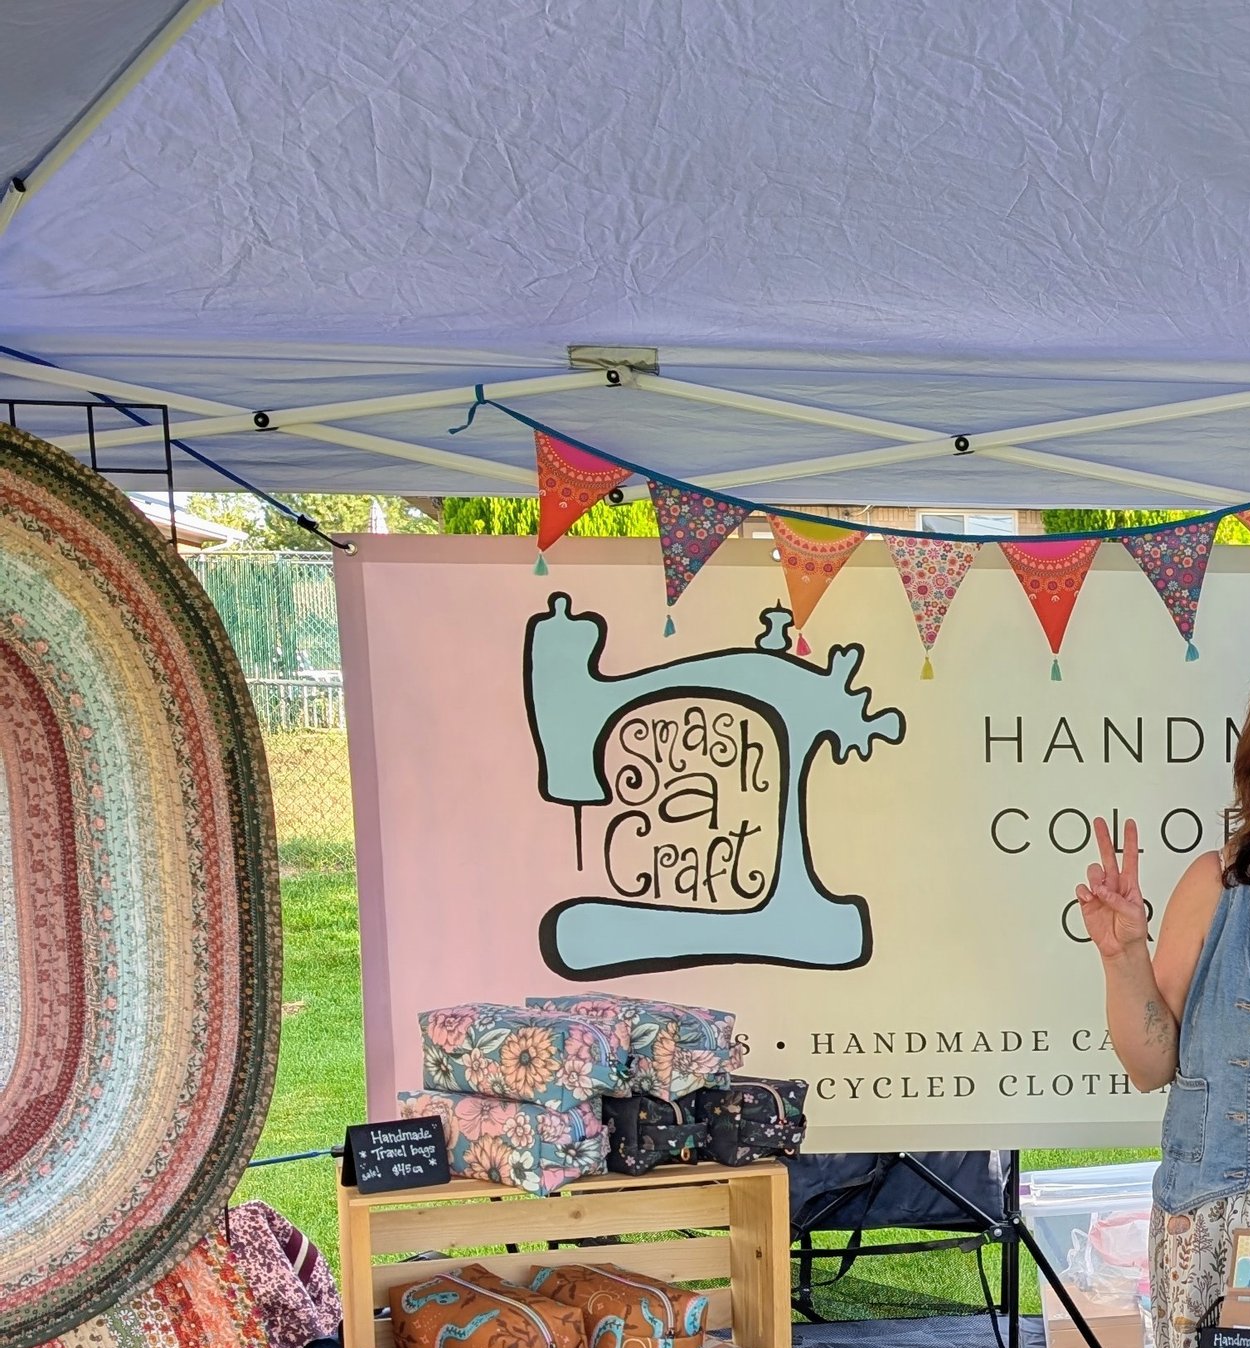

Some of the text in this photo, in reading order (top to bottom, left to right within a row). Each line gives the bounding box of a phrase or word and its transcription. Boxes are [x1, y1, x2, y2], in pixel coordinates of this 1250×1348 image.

[615, 706, 769, 806] Smash
[658, 772, 719, 830] a
[604, 820, 765, 903] Craft
[811, 1030, 1049, 1055] HANDMADE
[816, 1073, 1166, 1099] CYCLED CLOTH
[371, 1128, 432, 1144] Handmade
[371, 1145, 435, 1160] Travel bags
